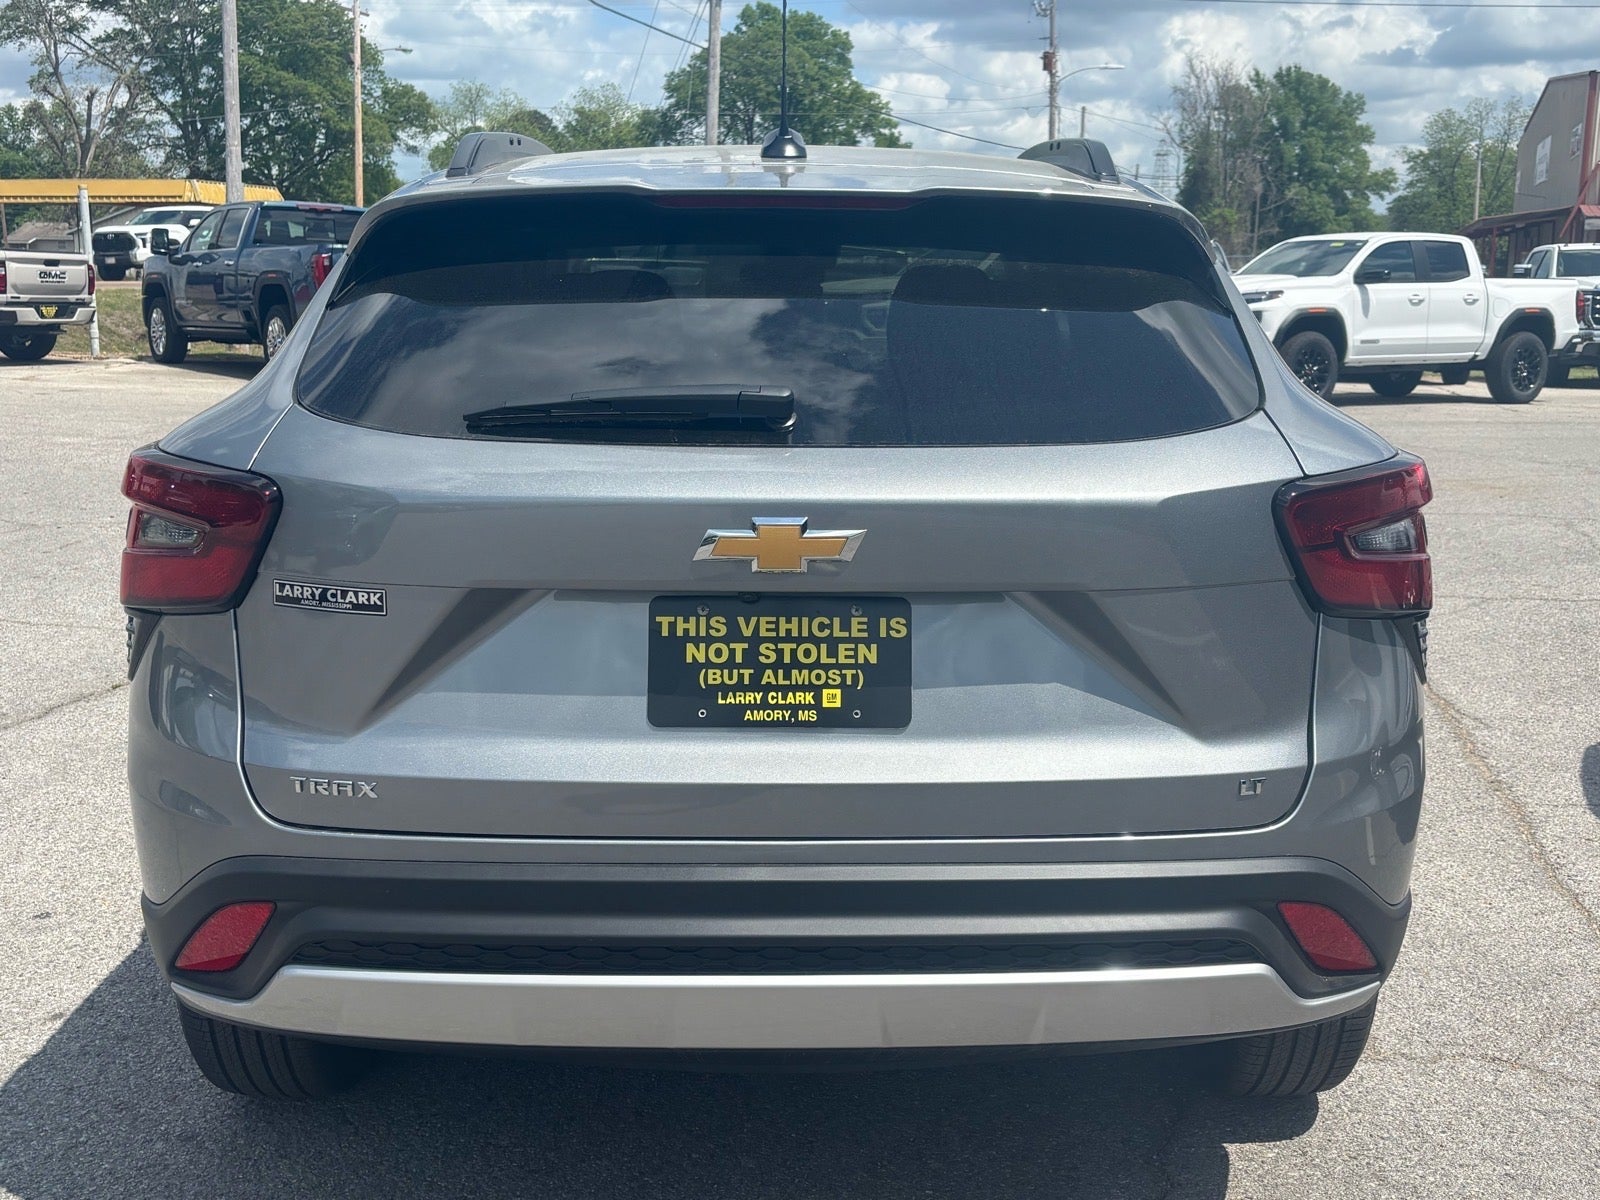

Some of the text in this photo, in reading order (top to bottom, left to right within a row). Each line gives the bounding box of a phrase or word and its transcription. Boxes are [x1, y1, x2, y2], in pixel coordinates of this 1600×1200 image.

[38, 271, 67, 280] GMC
[275, 583, 383, 605] LARRY CLARK
[655, 616, 908, 638] THIS VEHICLE IS
[685, 643, 878, 664] NOT STOLEN
[699, 669, 865, 690] (BUT ALMOST)
[717, 691, 764, 705] LARRY
[767, 691, 815, 705] CLARK
[743, 710, 817, 723] AMORY, MS
[289, 776, 378, 799] TRAX
[1240, 777, 1267, 796] LT
